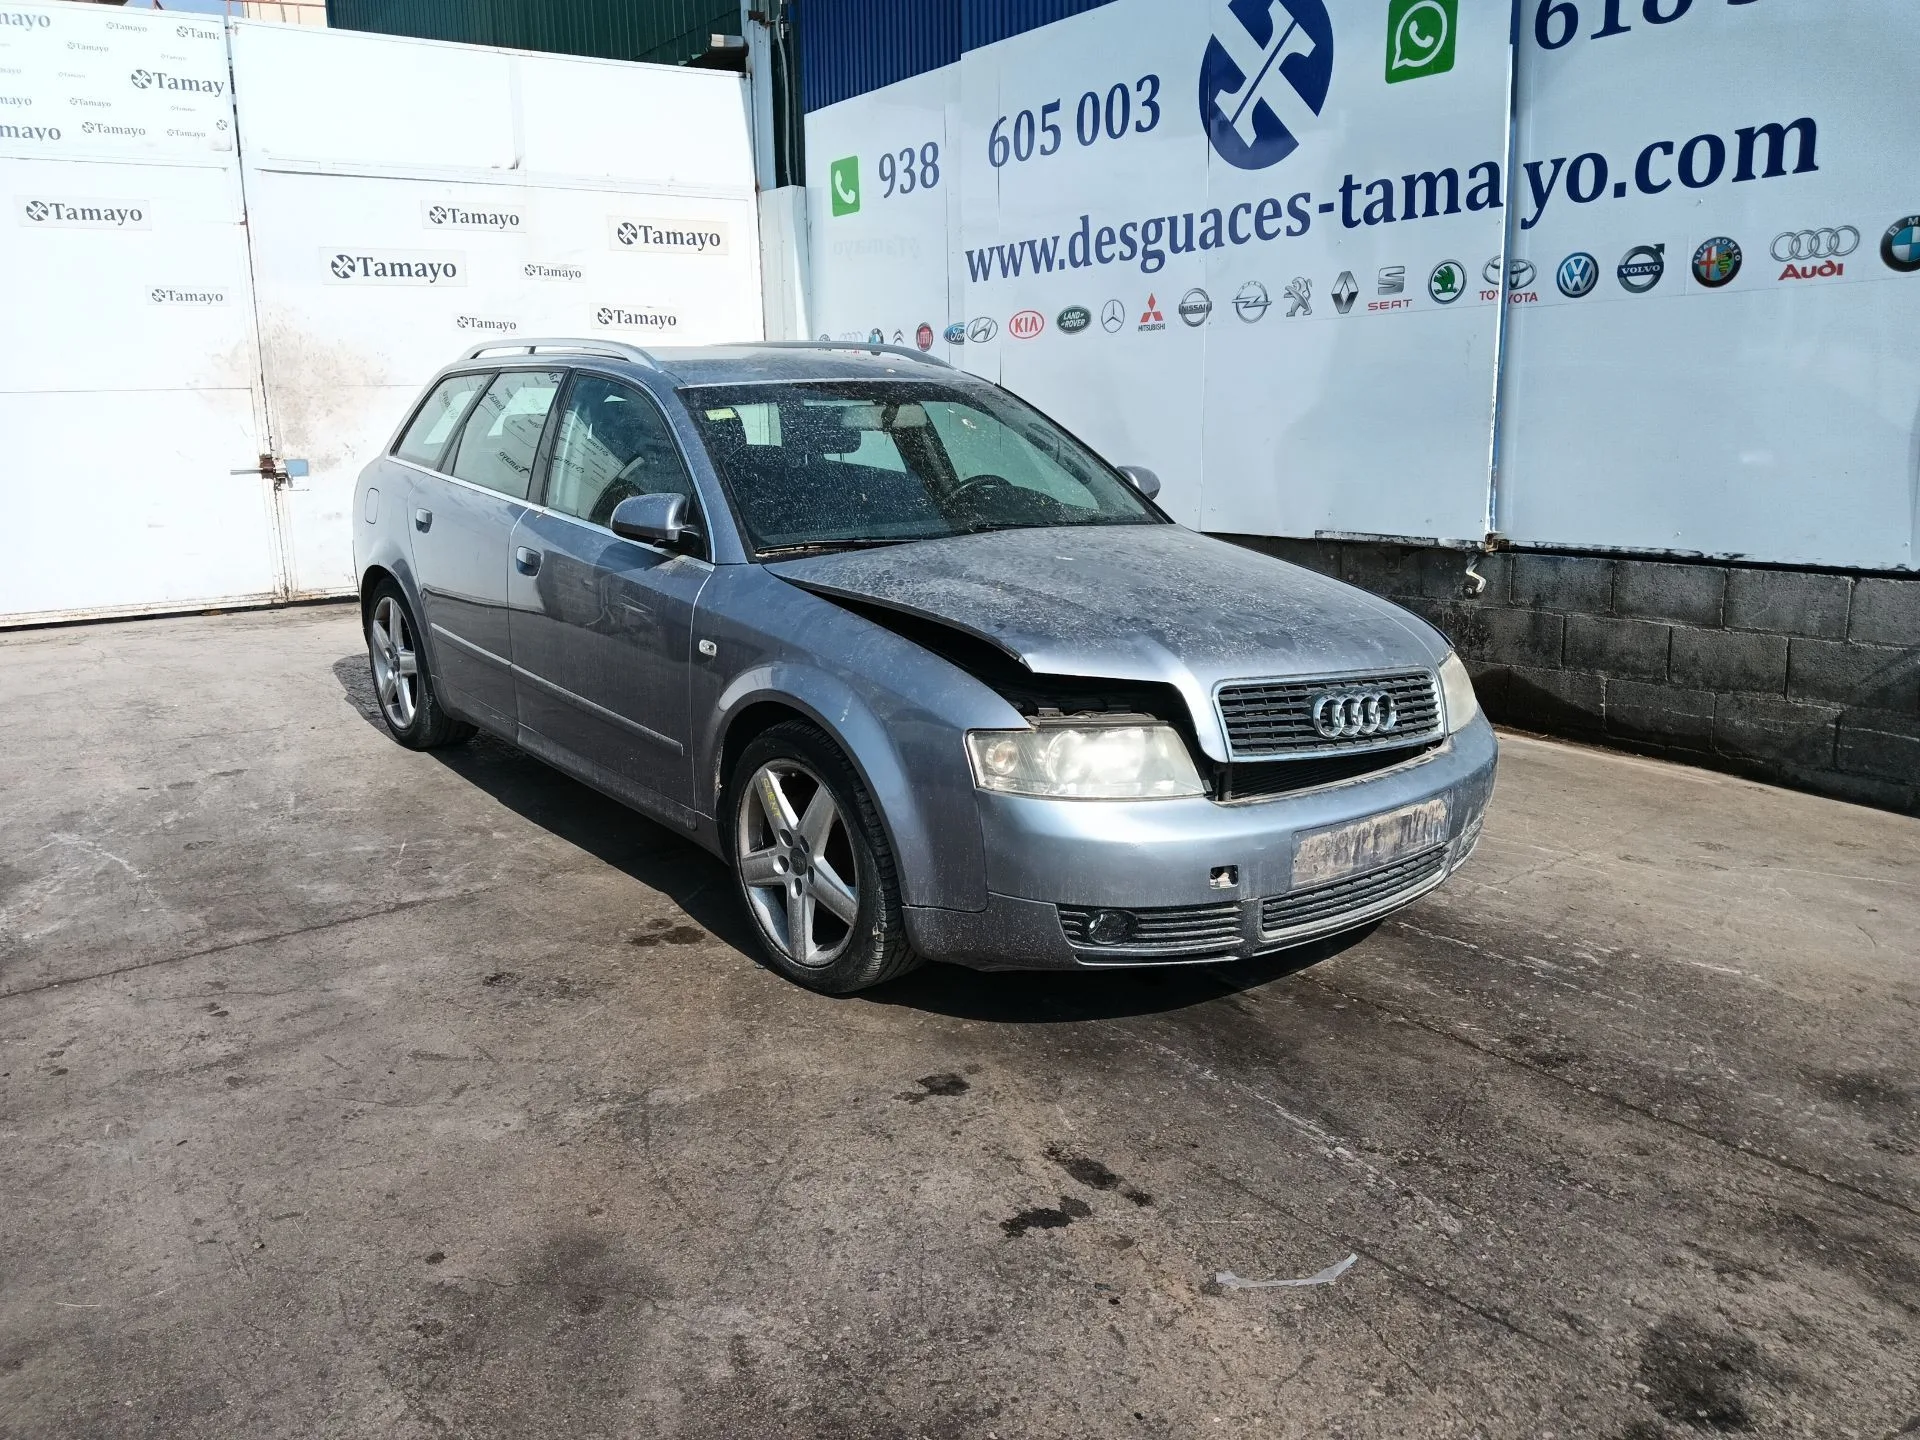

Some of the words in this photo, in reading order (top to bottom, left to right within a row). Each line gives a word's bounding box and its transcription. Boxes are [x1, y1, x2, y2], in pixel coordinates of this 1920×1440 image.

[115, 23, 148, 33] Tamayo
[77, 43, 109, 53] Tamayo
[152, 72, 225, 98] Tamay
[79, 98, 112, 109] Tamayo
[94, 123, 147, 138] Tamayo
[175, 129, 207, 139] Tamayo
[878, 142, 940, 199] 938
[988, 98, 1062, 168] 605
[1076, 73, 1161, 147] 003
[965, 117, 1819, 283] www.desguaces-tamayo.com
[50, 203, 143, 226] Tamayo
[448, 208, 520, 229] Tamayo
[639, 225, 721, 251] Tamayo
[357, 256, 457, 283] Tamayo
[536, 265, 582, 280] Tamayo
[1621, 264, 1661, 275] VOLVO
[1778, 260, 1844, 281] Audi
[166, 290, 224, 303] Tamayo
[1367, 299, 1413, 311] SEAT
[469, 317, 517, 332] Tamayo
[613, 309, 677, 328] Tamayo
[1015, 316, 1039, 333] KIA
[1064, 319, 1086, 328] ROVER
[1138, 323, 1166, 332] MITSUBISHI
